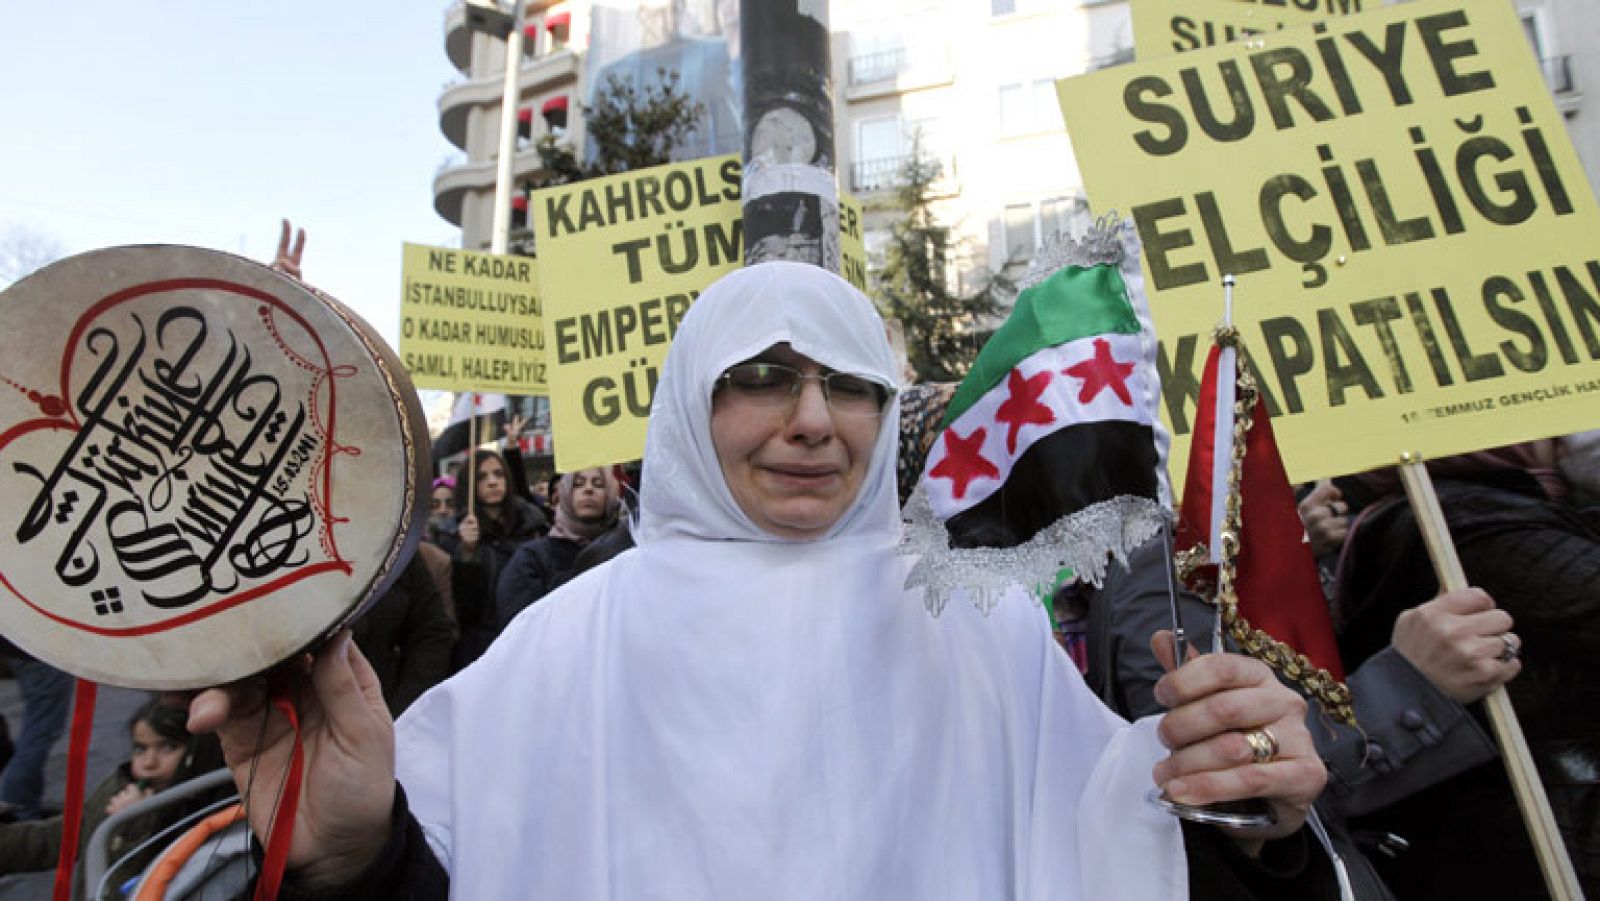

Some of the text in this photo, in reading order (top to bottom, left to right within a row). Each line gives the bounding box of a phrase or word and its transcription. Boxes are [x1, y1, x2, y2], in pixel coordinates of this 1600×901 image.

[1123, 9, 1496, 156] SURİYE
[1132, 106, 1574, 290] ELÇİLİĞİ
[428, 250, 531, 283] NE KADAR
[612, 219, 744, 284] TÜM
[403, 316, 415, 340] O
[418, 319, 472, 342] KADAR
